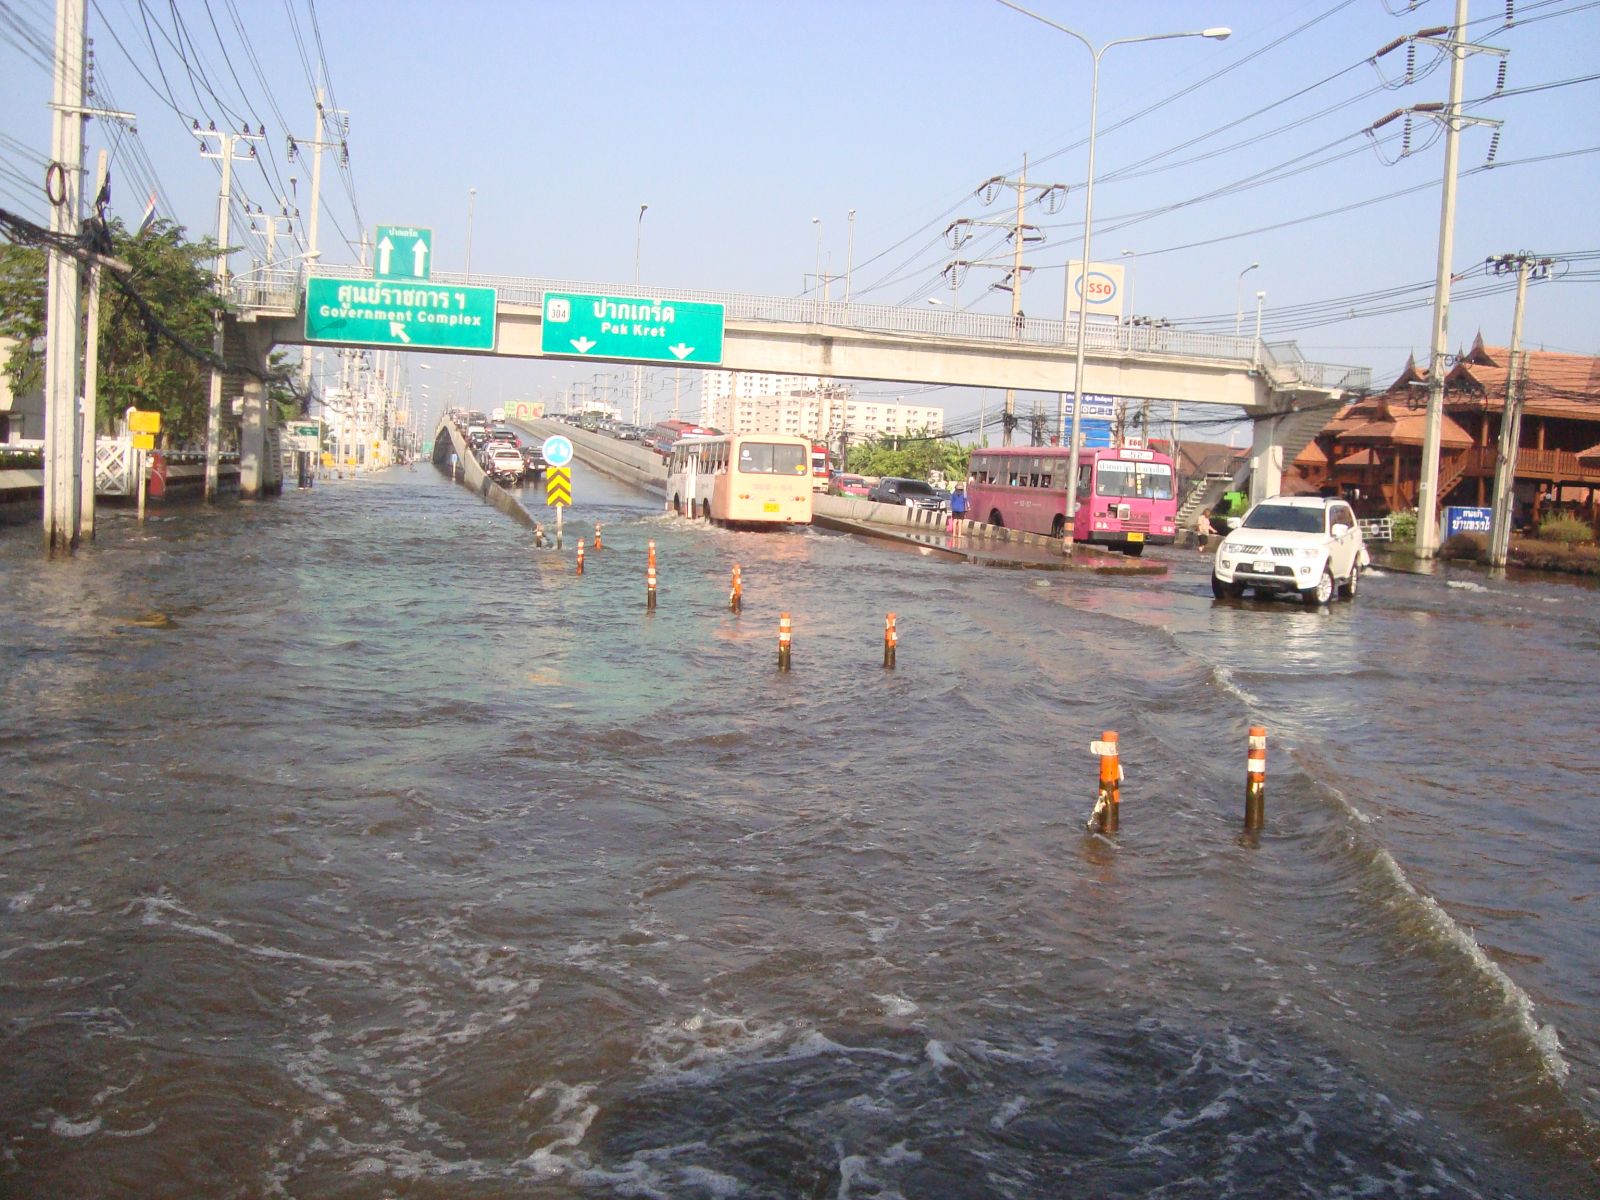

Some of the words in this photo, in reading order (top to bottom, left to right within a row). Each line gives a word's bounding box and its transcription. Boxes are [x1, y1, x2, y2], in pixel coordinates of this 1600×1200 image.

[338, 282, 449, 309] ศูนย์ราชการ
[1083, 282, 1112, 296] SSO
[320, 305, 412, 322] Government
[417, 311, 481, 326] Complex
[552, 308, 567, 319] 304
[593, 297, 675, 323] ปากเกร็ด
[601, 322, 628, 335] Pak
[633, 323, 666, 338] Kret
